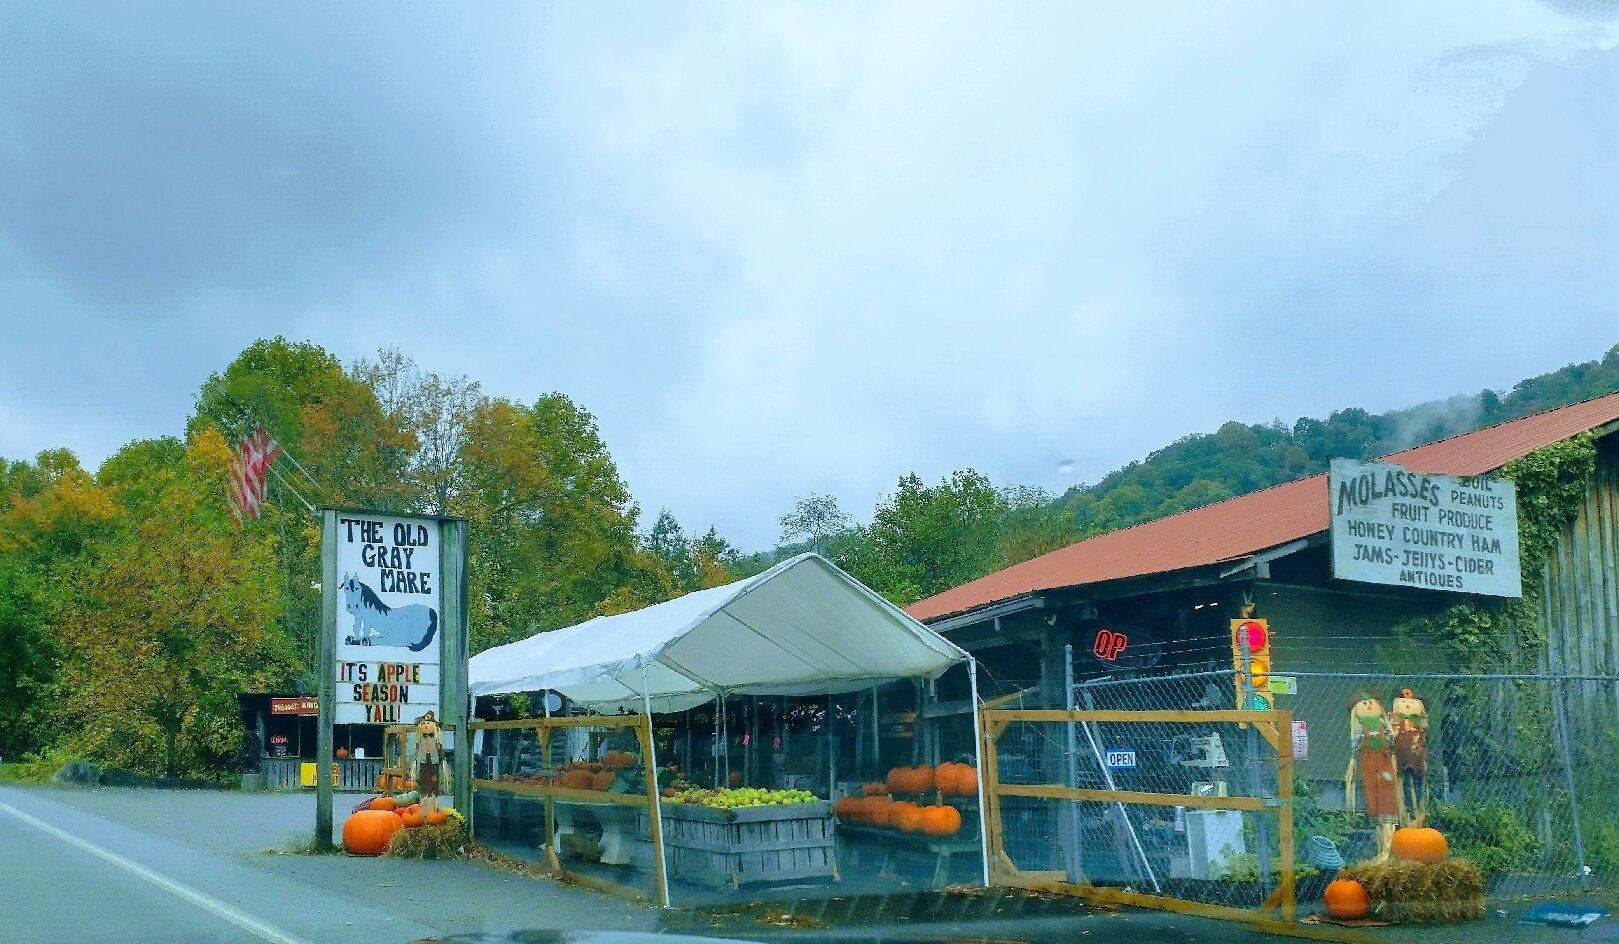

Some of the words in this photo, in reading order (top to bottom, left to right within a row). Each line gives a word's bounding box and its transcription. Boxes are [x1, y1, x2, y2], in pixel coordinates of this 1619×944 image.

[1337, 470, 1440, 517] MOLASSES
[1451, 490, 1504, 510] PEANUTS
[1392, 502, 1430, 523] FRUIT
[1438, 508, 1493, 532] PRODUCE
[340, 518, 384, 544] THE
[393, 522, 429, 547] OLD
[1347, 519, 1395, 541] HONEY
[1402, 526, 1464, 550] COUNTRY
[1471, 534, 1502, 554] HAM
[361, 543, 415, 570] GRAY
[1455, 555, 1494, 576] CIDER
[380, 568, 432, 595] MARE
[1399, 569, 1464, 589] ANTIQUES
[340, 662, 368, 682] IT'S
[378, 663, 420, 683] APPLE
[353, 683, 409, 704] SEASON
[365, 704, 401, 723] YALL!
[1110, 753, 1134, 766] OPEN
